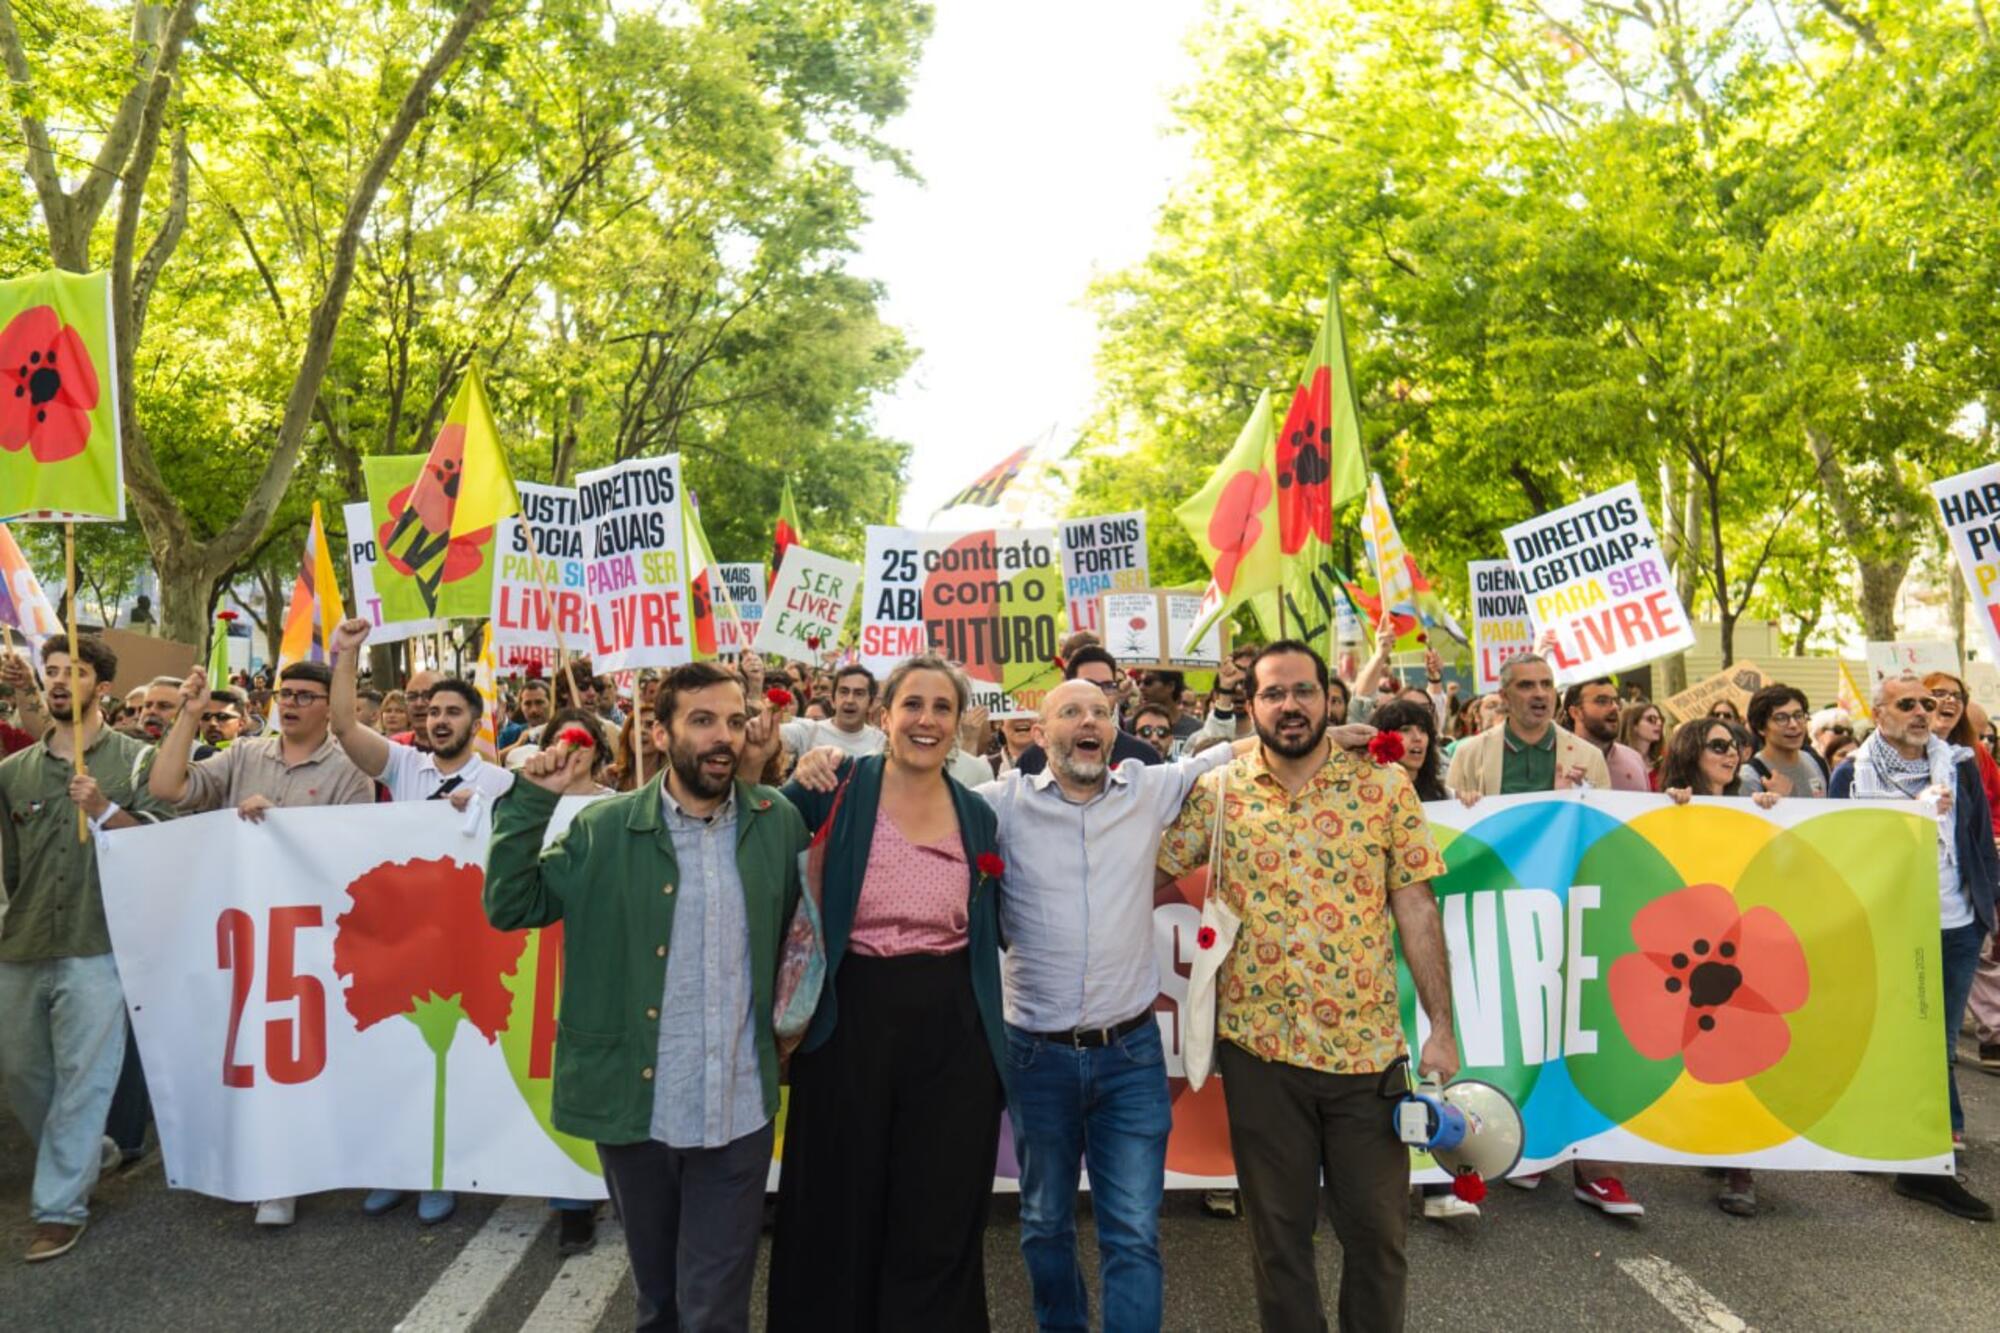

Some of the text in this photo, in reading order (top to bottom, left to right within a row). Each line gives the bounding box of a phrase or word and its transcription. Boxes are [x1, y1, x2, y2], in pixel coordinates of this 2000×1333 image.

[510, 488, 580, 526] USTI
[579, 466, 674, 521] DIREITOS
[594, 512, 665, 558] IGUAIS
[1066, 518, 1139, 549] UM SNS
[1514, 497, 1639, 564] DIREITOS
[587, 549, 678, 596] PARA SER
[881, 550, 917, 582] 25
[924, 540, 1051, 572] contrato
[1075, 545, 1136, 574] FORTE
[1519, 532, 1654, 594] LGBTQIAP+
[720, 567, 751, 584] MAIS
[798, 568, 844, 599] SER
[933, 578, 1045, 606] com o
[1068, 568, 1145, 597] PARA SER
[1536, 559, 1662, 624] PARA SER
[499, 585, 590, 634] LiVR
[591, 591, 684, 656] LiVRE
[787, 587, 843, 625] LIVRE
[1071, 598, 1099, 632] Li
[863, 624, 926, 657] SEM
[926, 614, 1057, 666] FUTURO
[1481, 620, 1527, 642] PARA
[971, 691, 1011, 713] iVRE
[1413, 885, 1601, 1068] VRE
[217, 905, 327, 1089] 25
